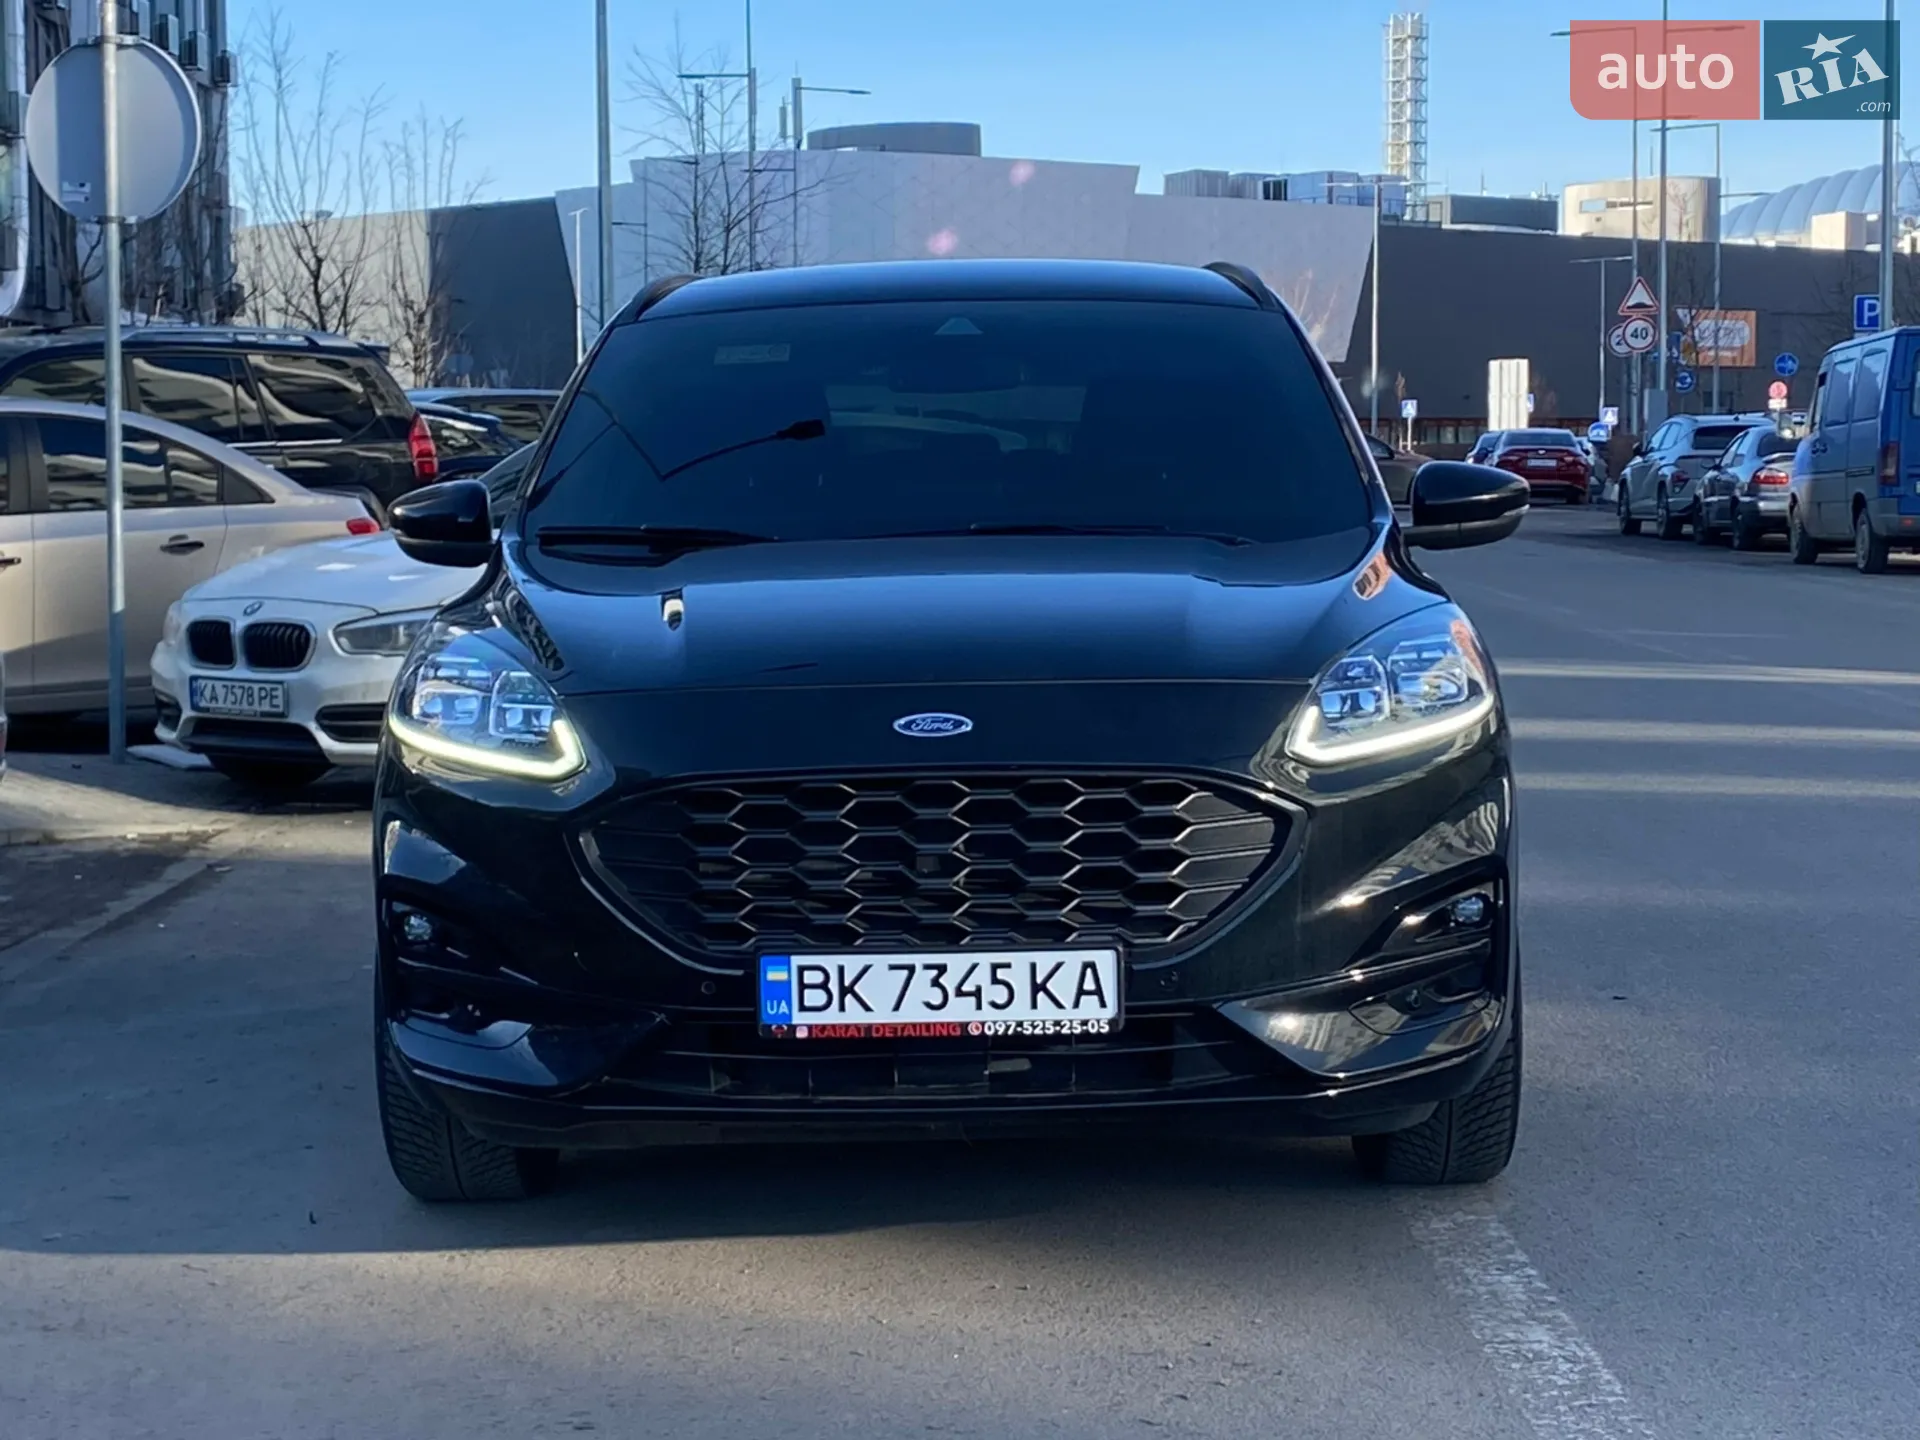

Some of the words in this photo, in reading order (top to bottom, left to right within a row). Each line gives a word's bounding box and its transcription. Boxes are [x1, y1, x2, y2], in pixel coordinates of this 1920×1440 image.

[1863, 299, 1881, 326] P
[1630, 327, 1649, 341] 40
[200, 682, 220, 705] KA
[221, 683, 255, 707] 7578
[258, 686, 280, 709] PE
[911, 717, 955, 731] Ford
[796, 964, 875, 1013] BK
[887, 961, 1016, 1011] 7345
[1028, 960, 1107, 1010] KA
[766, 999, 790, 1015] UA
[812, 1024, 867, 1038] KARAT
[872, 1022, 961, 1037] DETAILING
[983, 1019, 1110, 1035] 097-525-25-05
